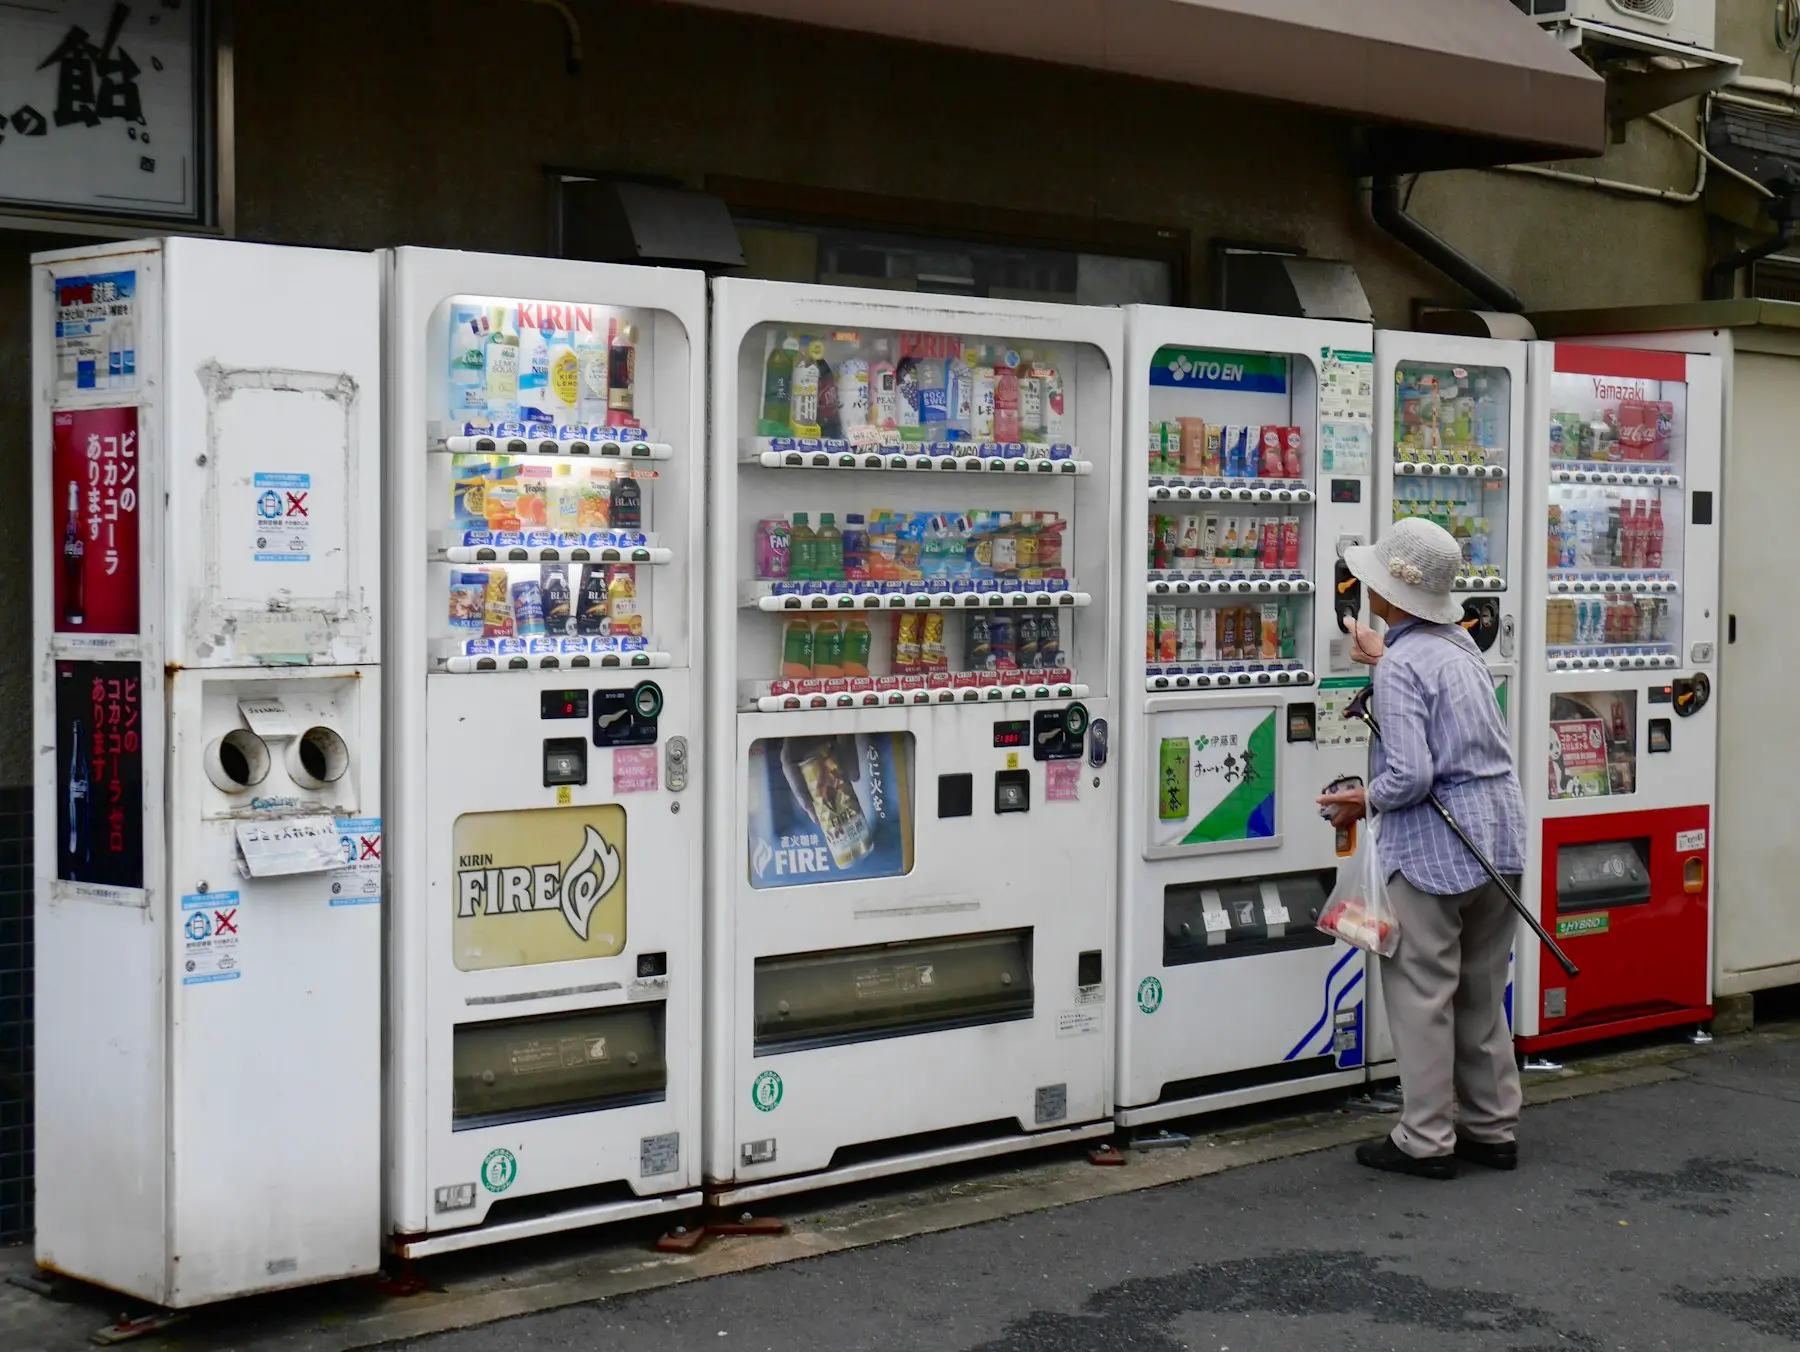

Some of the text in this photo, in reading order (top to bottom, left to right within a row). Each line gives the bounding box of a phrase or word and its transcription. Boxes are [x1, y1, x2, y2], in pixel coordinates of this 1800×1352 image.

[517, 303, 594, 332] KIRIN
[1190, 363, 1243, 381] ITO EN
[1592, 377, 1646, 401] Yamazaki
[87, 433, 102, 541] あります
[121, 431, 136, 512] ビンの
[103, 436, 119, 576] コカ・コーラ
[91, 677, 107, 782] あります
[123, 677, 139, 752] ビンの
[1210, 734, 1238, 747] 伊藤園
[459, 853, 493, 867] KIRIN
[775, 846, 831, 875] FIRE
[457, 861, 562, 919] FIRE
